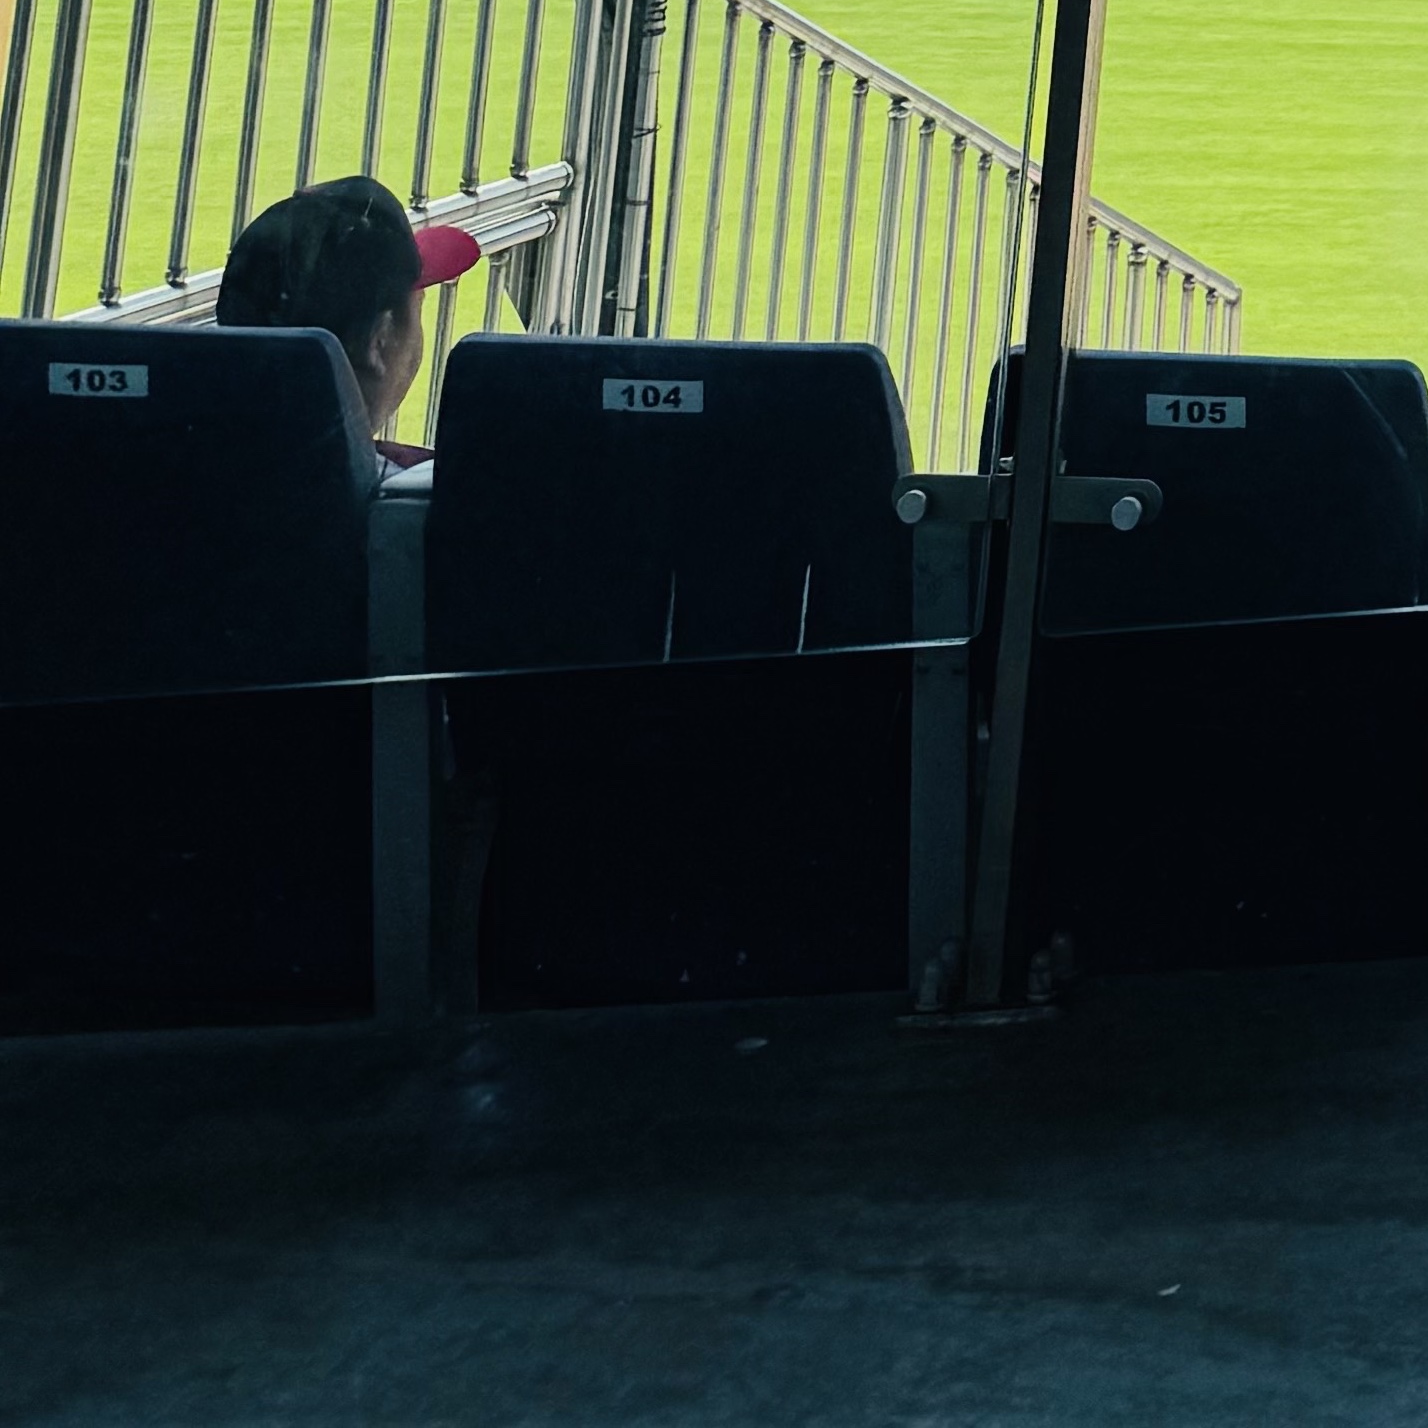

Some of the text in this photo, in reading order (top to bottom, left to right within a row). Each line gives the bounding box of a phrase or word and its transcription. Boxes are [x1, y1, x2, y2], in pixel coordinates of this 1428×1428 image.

[65, 369, 128, 392] 103
[620, 385, 682, 409] 104
[1163, 399, 1227, 424] 105
